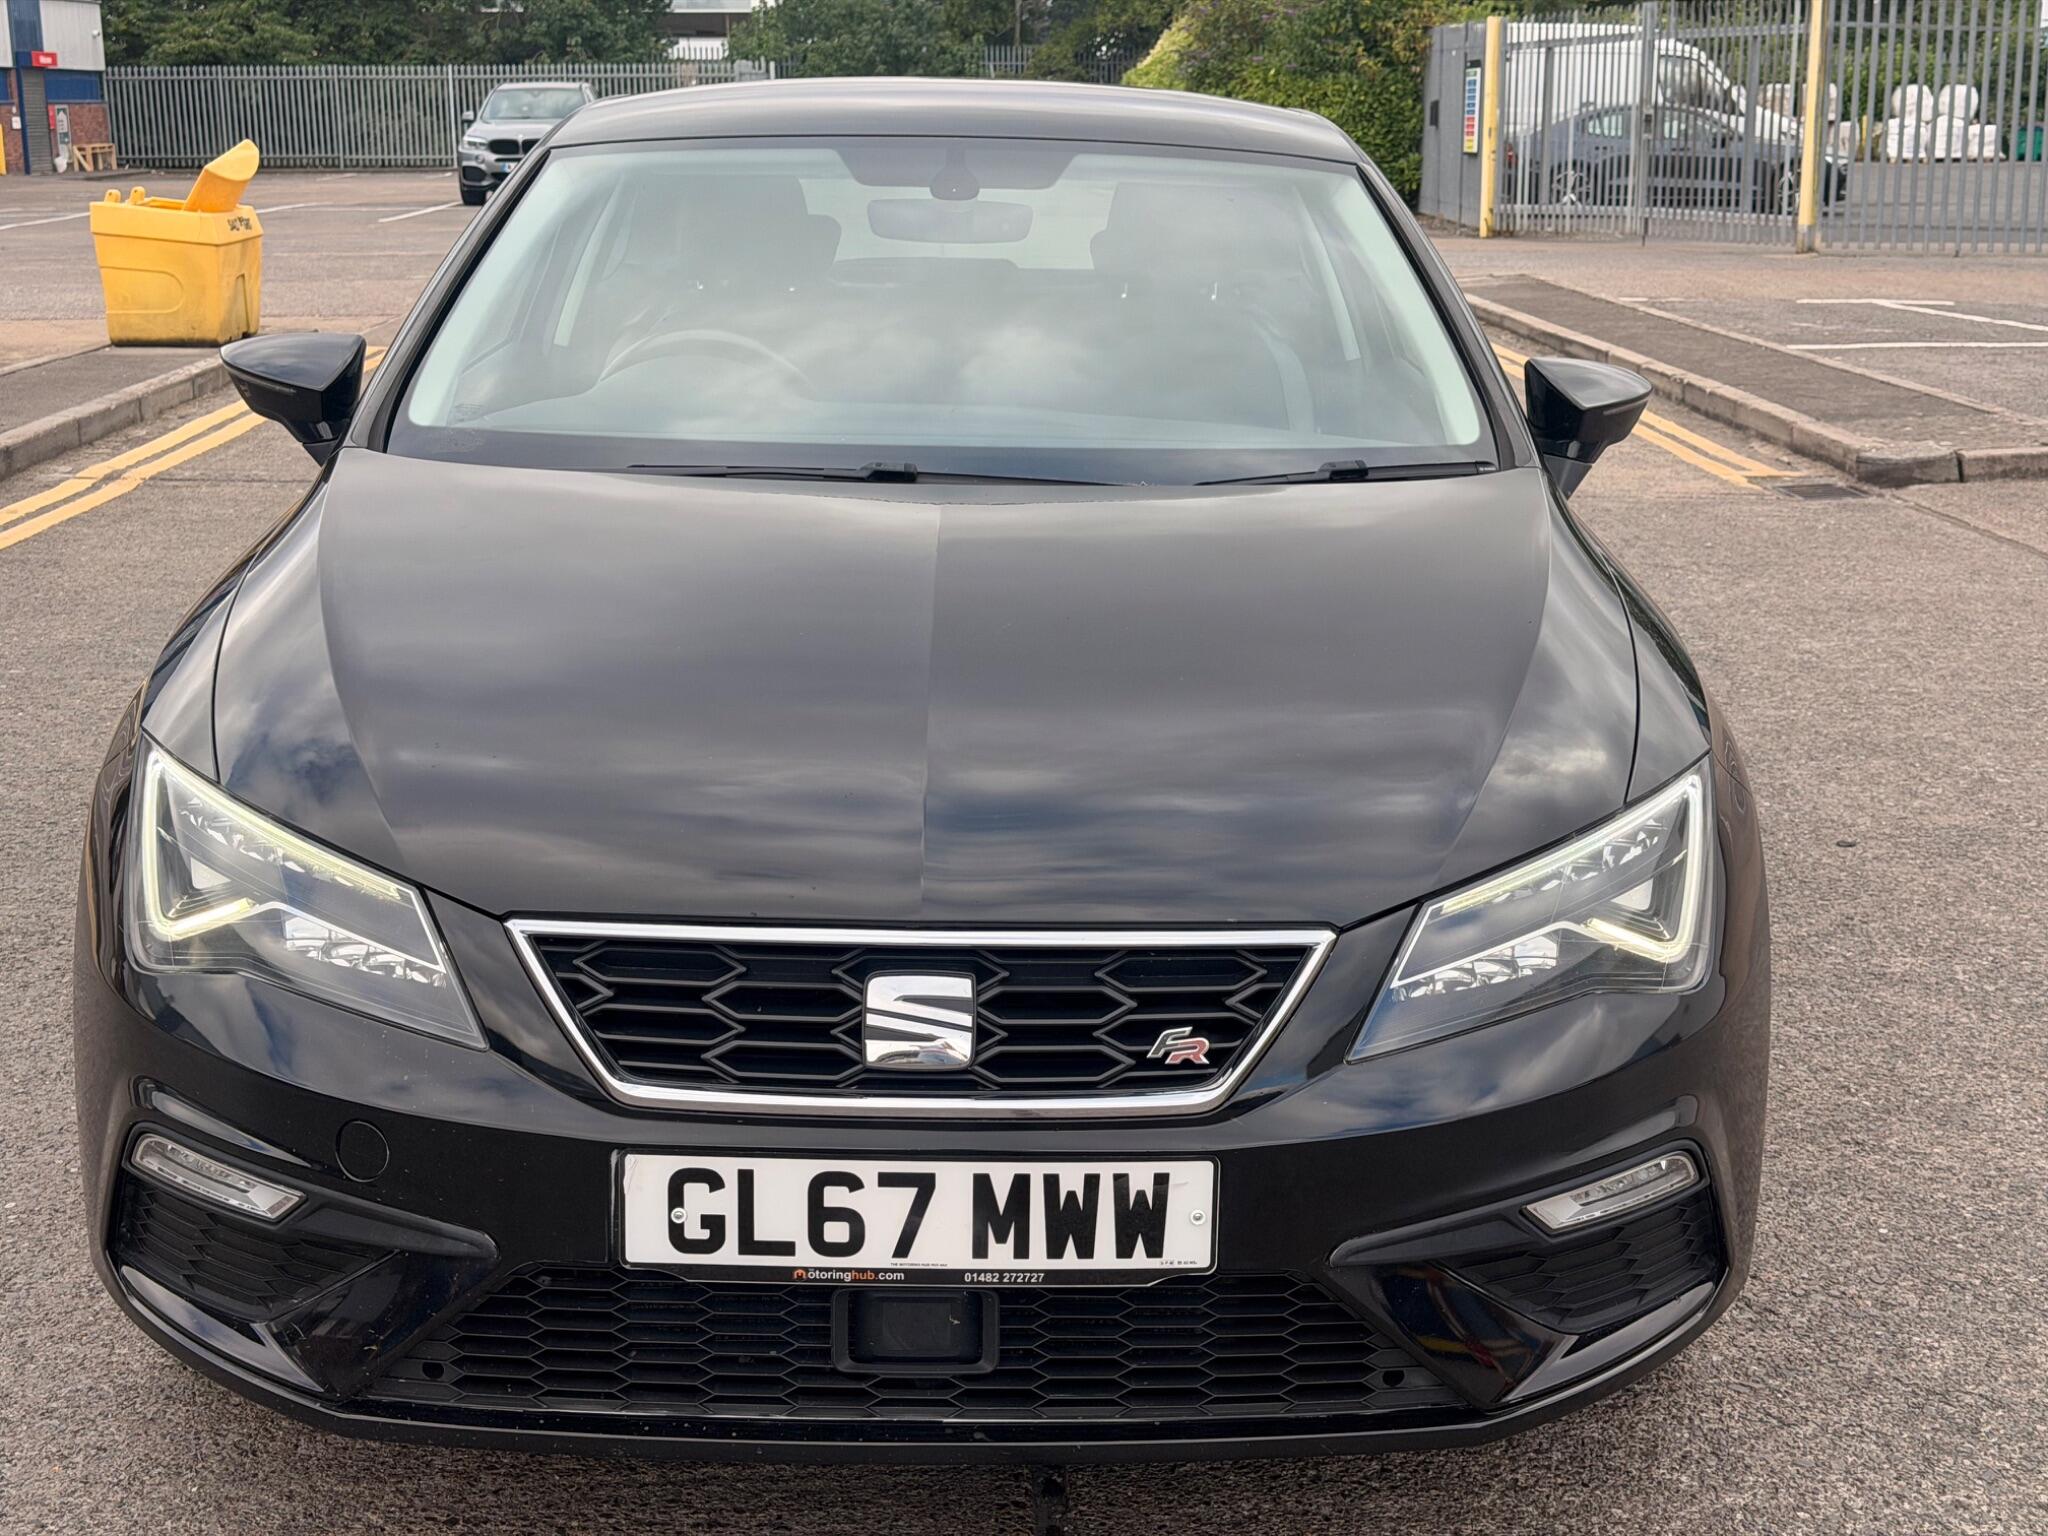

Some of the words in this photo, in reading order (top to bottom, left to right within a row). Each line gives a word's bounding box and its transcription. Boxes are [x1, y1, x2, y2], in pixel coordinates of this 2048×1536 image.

[1146, 1026, 1210, 1065] FR
[667, 1167, 937, 1259] GL67
[971, 1172, 1171, 1261] MWW
[964, 1272, 1000, 1282] 01482
[1003, 1273, 1045, 1283] 272727
